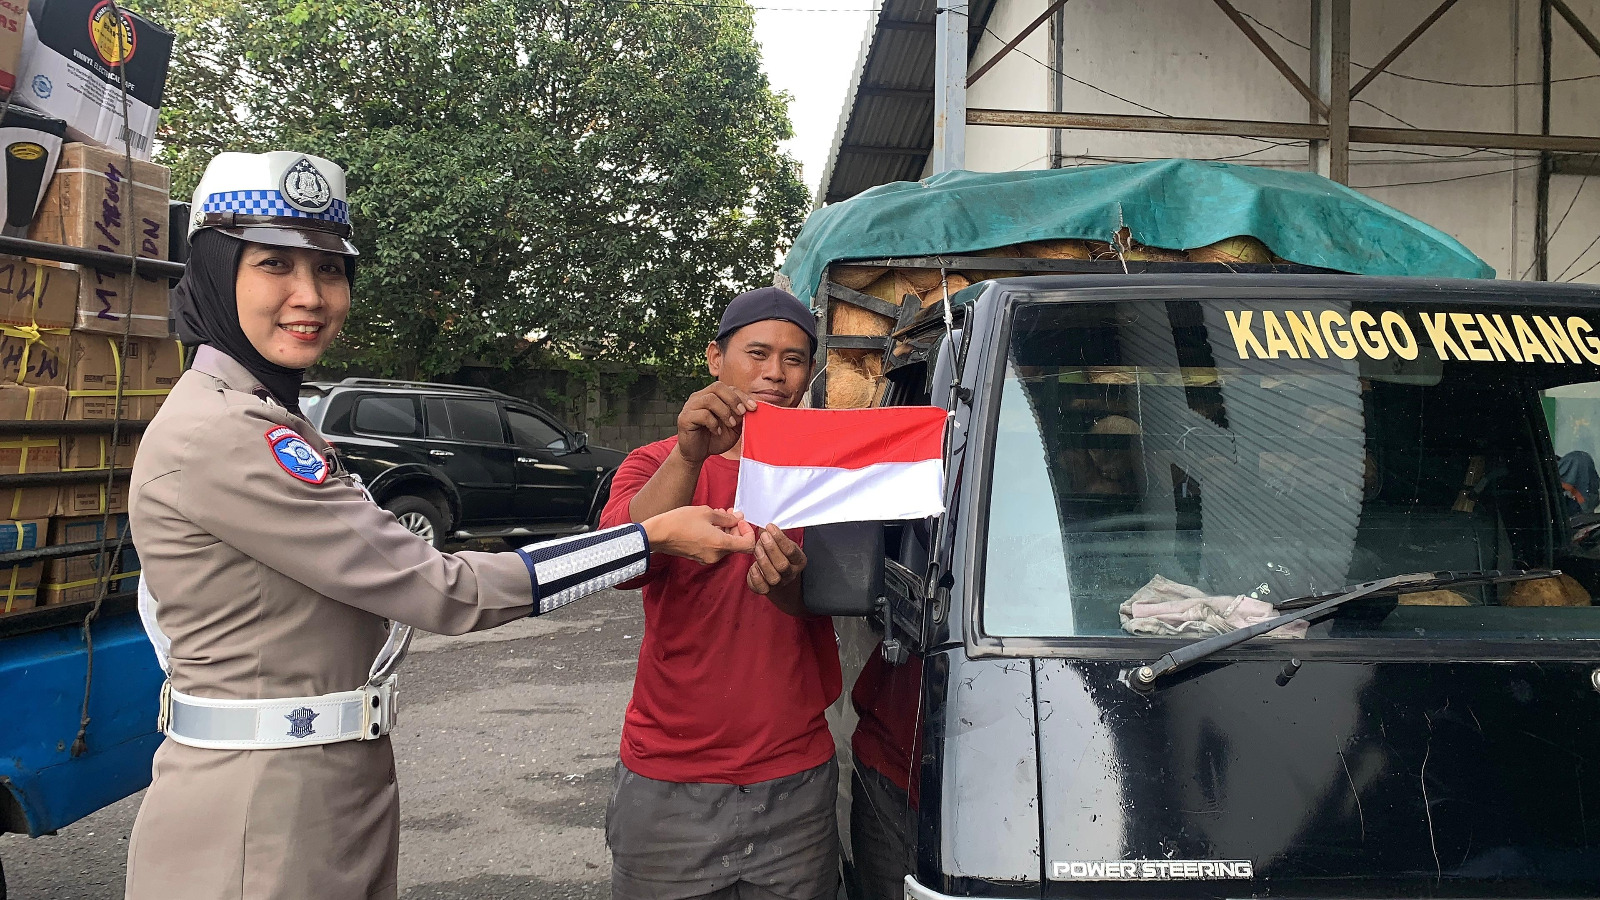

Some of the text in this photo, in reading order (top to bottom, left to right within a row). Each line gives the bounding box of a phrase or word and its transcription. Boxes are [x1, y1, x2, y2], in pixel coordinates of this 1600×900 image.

[1224, 310, 1600, 366] KANGGO KENANG
[1053, 862, 1252, 878] POWER STEERING
